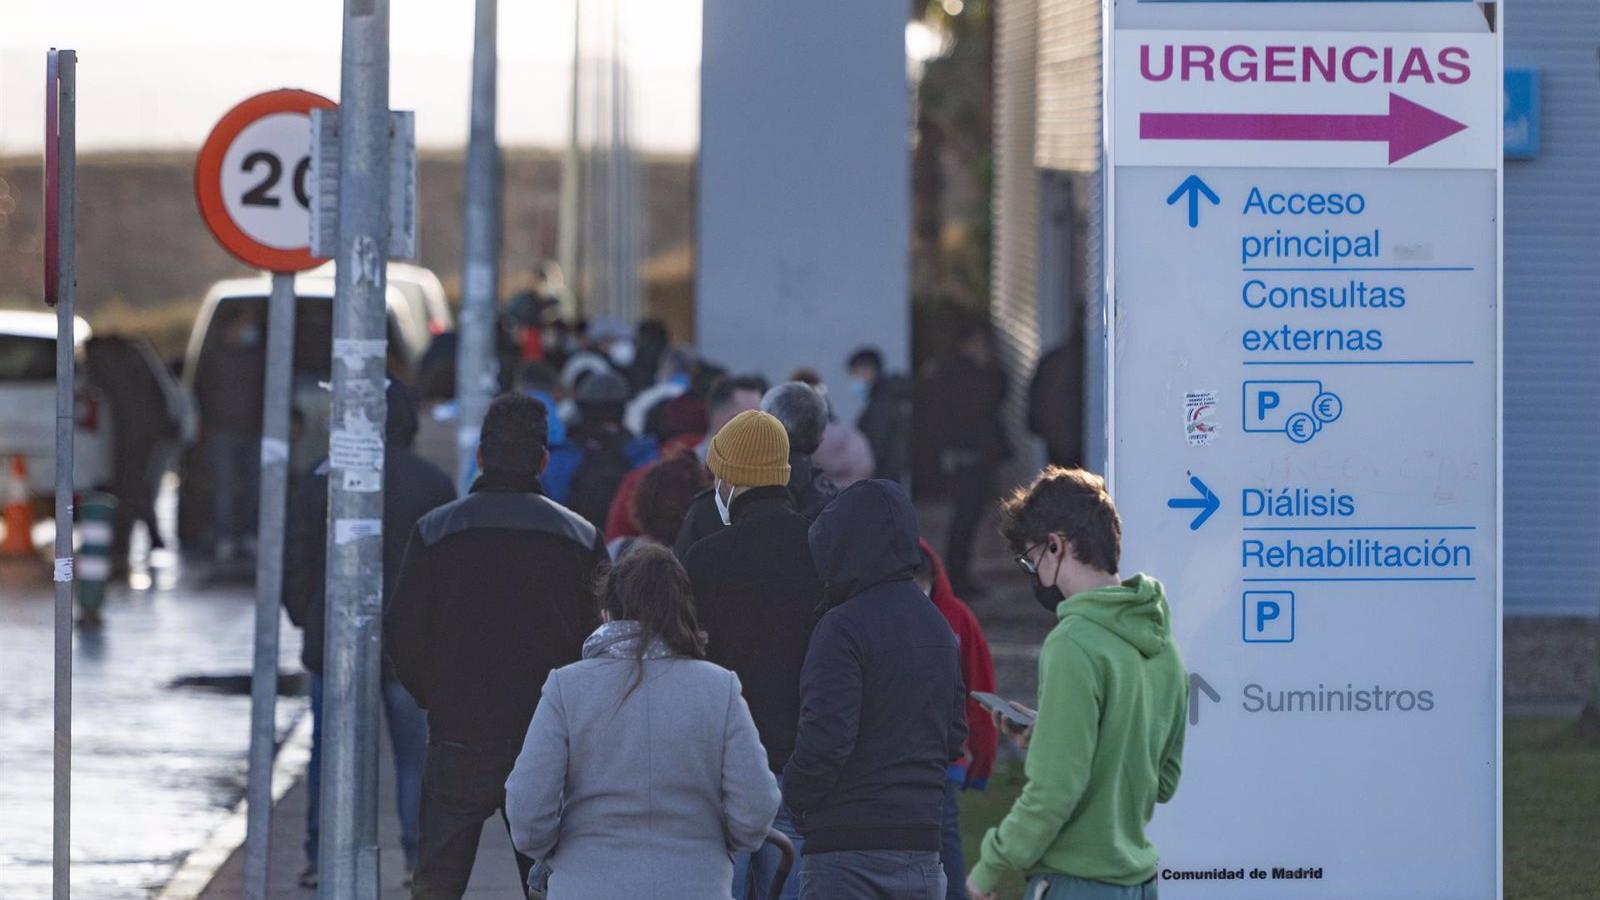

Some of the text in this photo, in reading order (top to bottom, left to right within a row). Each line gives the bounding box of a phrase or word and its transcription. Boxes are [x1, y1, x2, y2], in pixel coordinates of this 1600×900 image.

[1139, 44, 1472, 85] URGENCIAS
[1243, 187, 1365, 215] Acceso
[1242, 229, 1380, 264] principal
[1242, 279, 1406, 309] Consultas
[1242, 324, 1383, 351] externas
[1257, 391, 1280, 421] P
[1242, 488, 1355, 517] Diálisis
[1242, 539, 1472, 568] Rehabilitación
[1256, 601, 1281, 632] P
[1242, 684, 1435, 712] Suministros
[1161, 867, 1324, 881] Comunidad de Madrid
